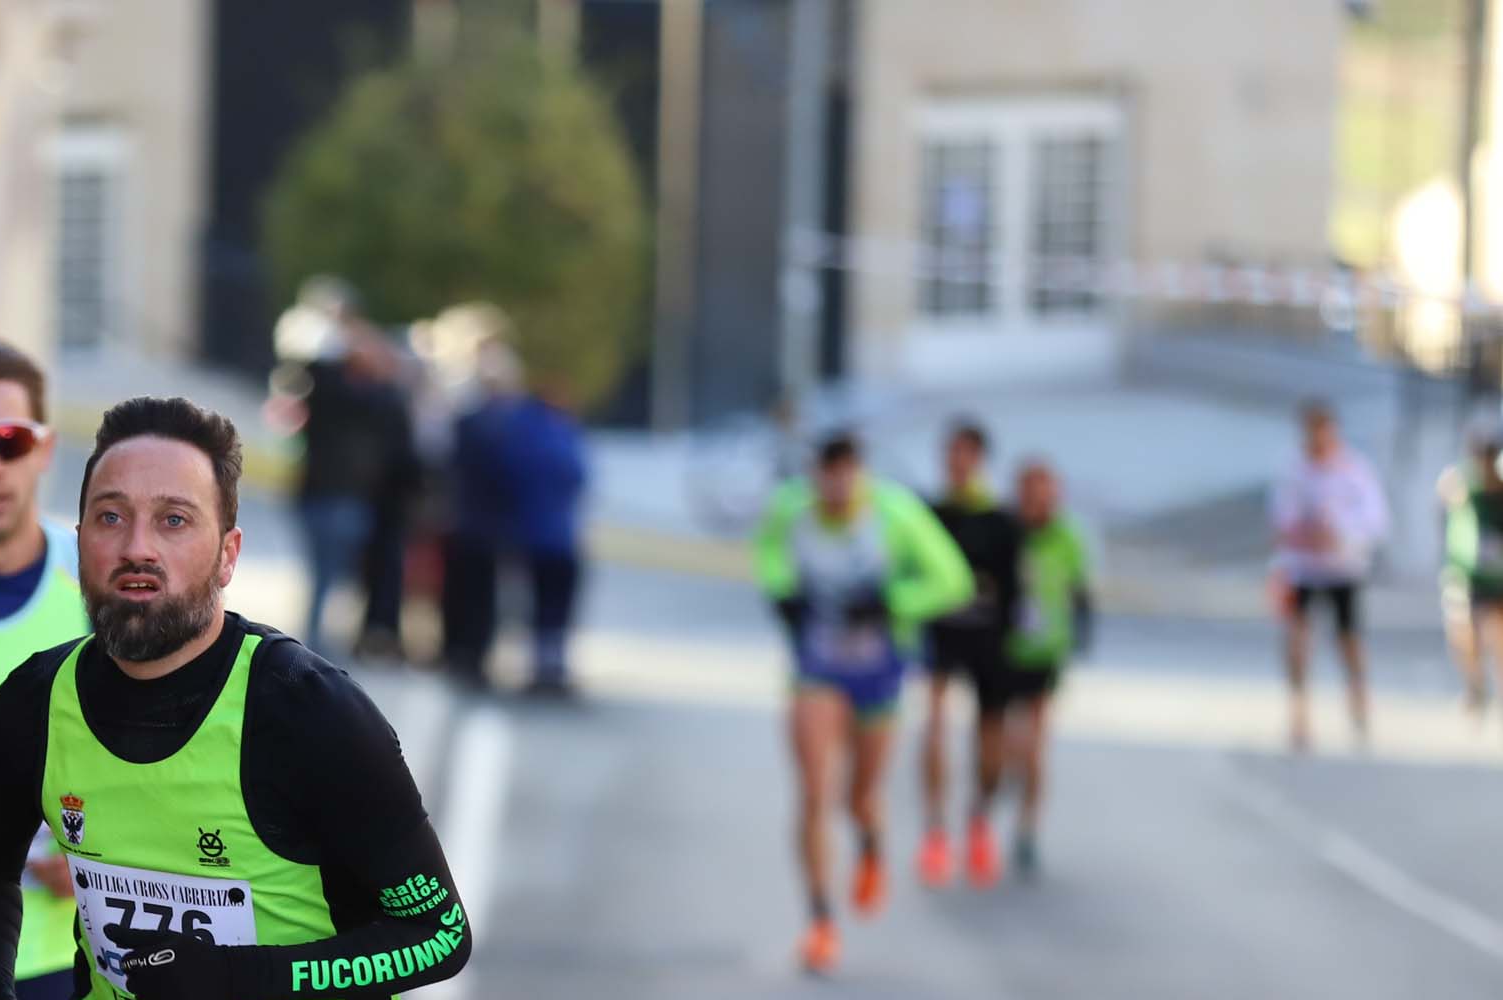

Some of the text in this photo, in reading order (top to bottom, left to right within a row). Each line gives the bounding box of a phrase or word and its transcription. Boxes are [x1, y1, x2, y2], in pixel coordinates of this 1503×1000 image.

[104, 872, 131, 894] LIGA
[133, 879, 170, 900] CROSS
[172, 885, 244, 907] CABRERIZ
[378, 876, 440, 908] Santos
[380, 873, 427, 900] Rafa
[104, 896, 216, 946] 776
